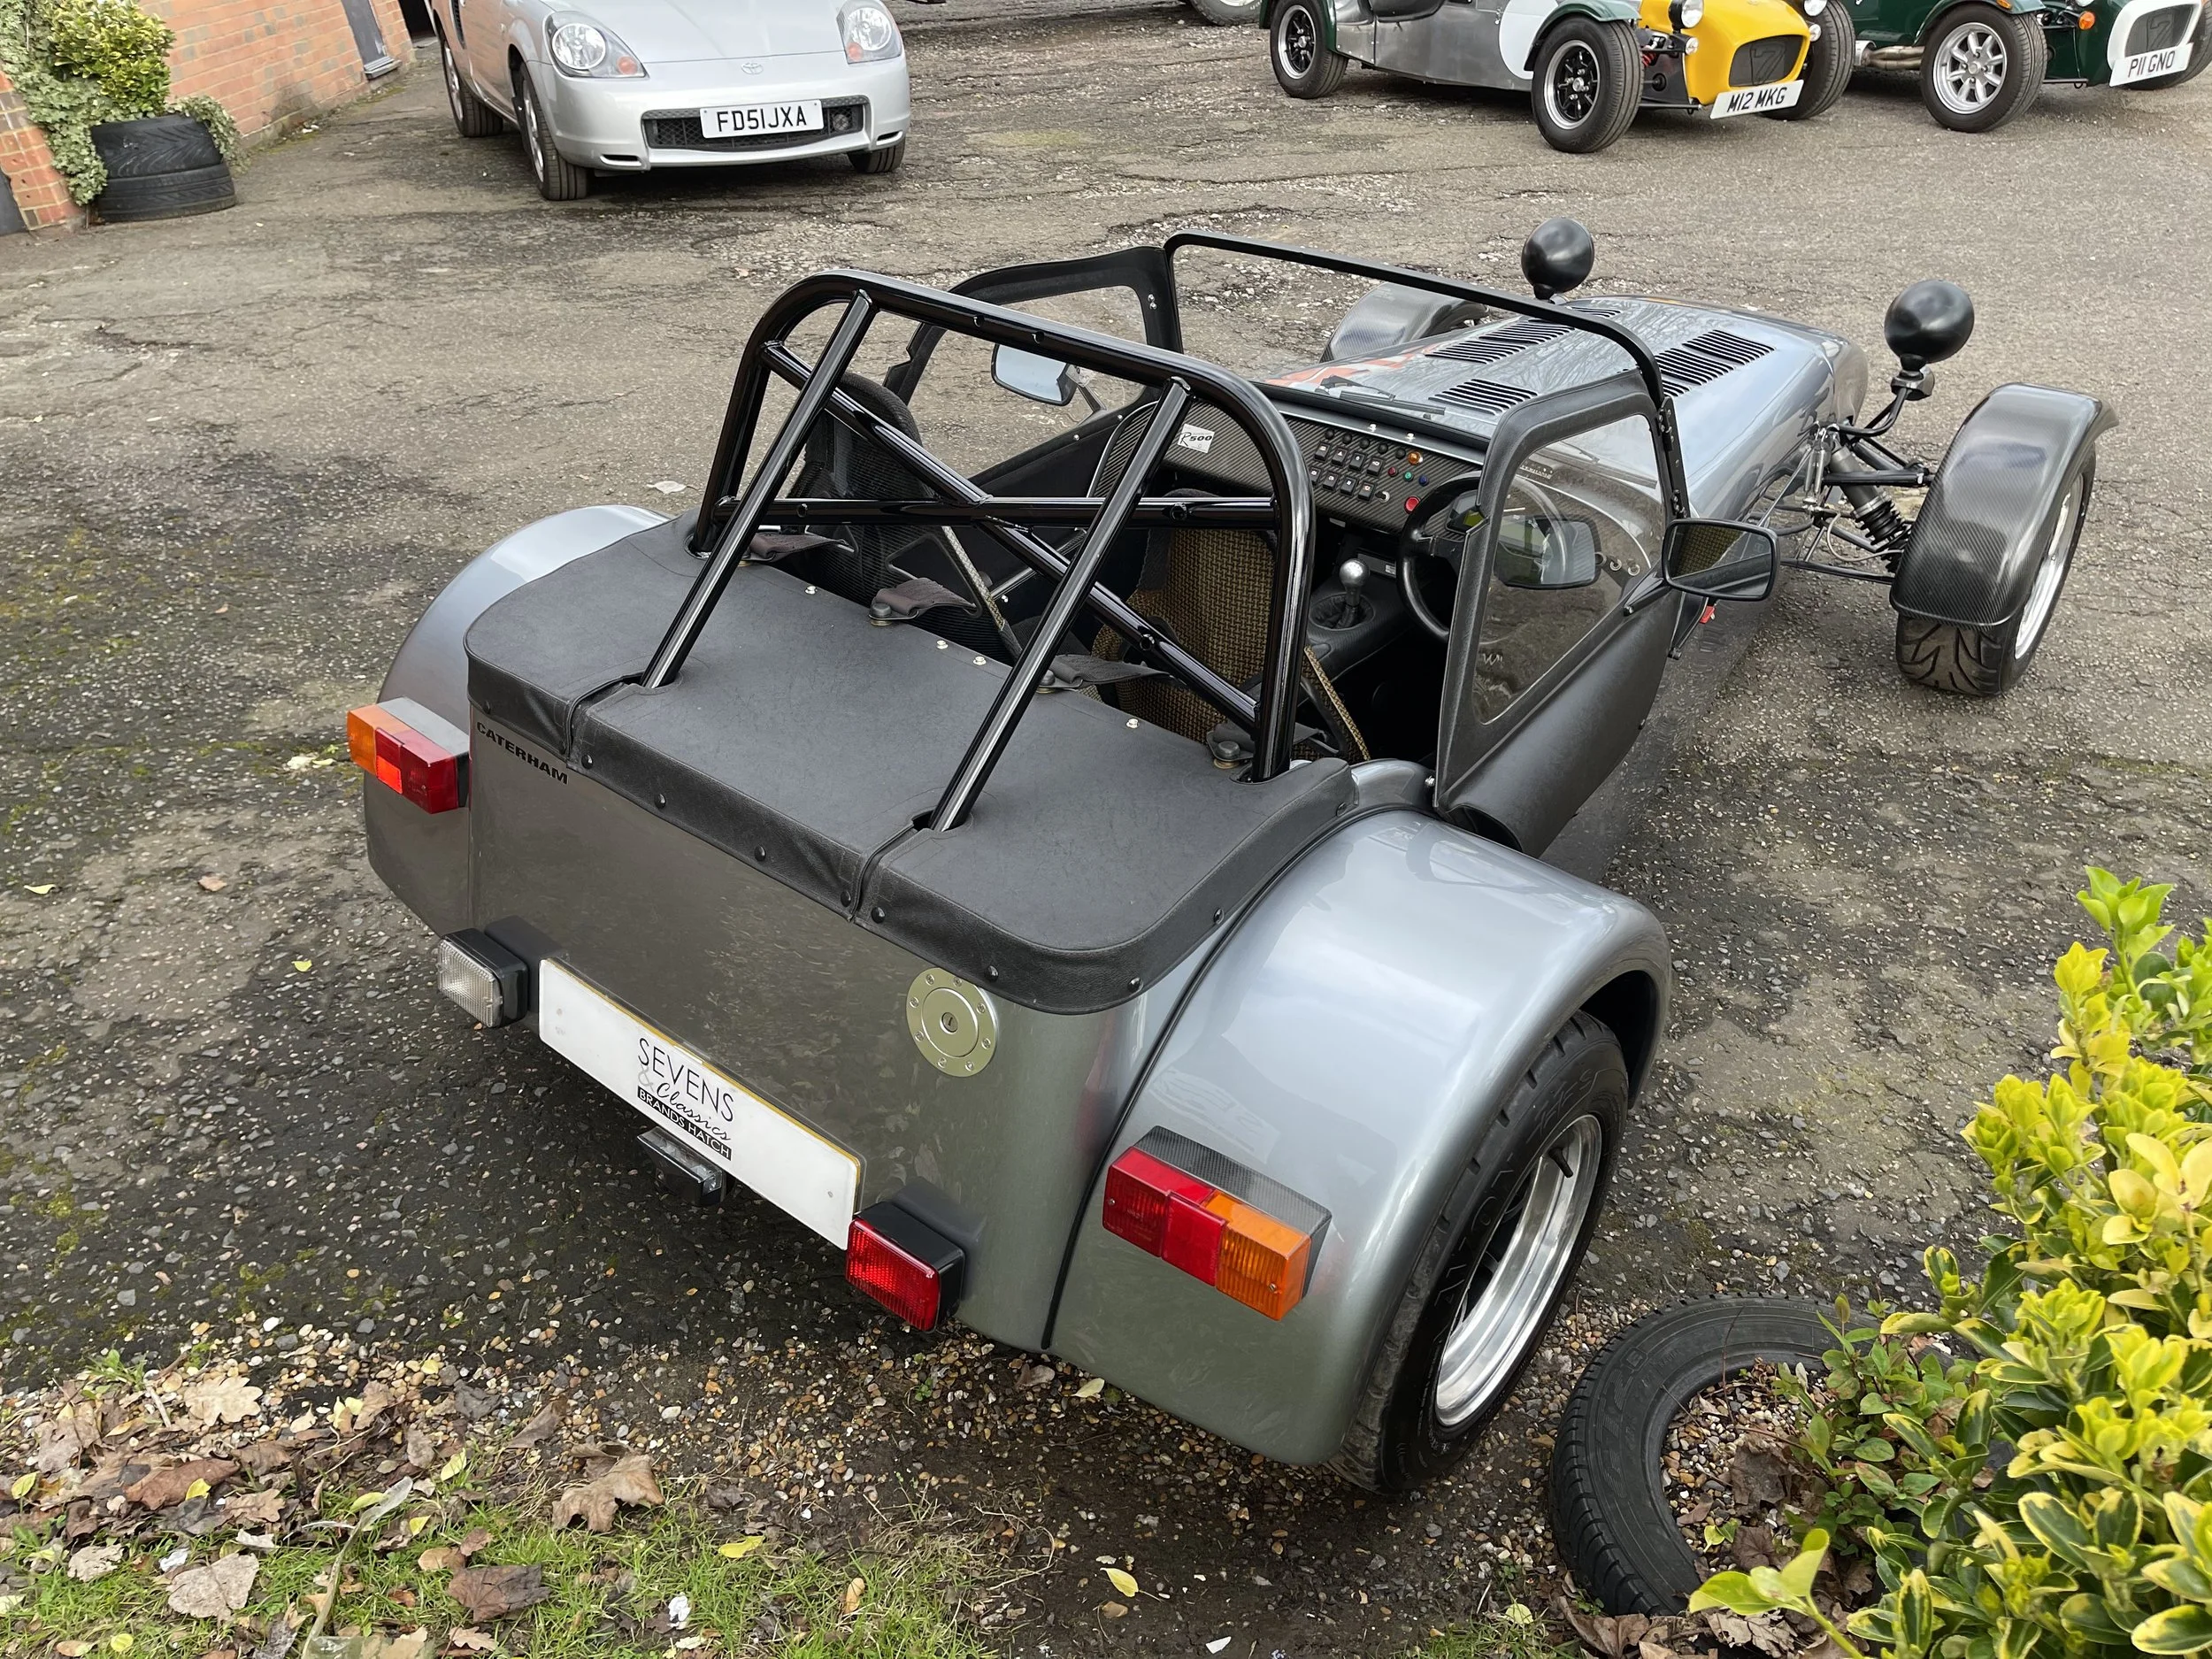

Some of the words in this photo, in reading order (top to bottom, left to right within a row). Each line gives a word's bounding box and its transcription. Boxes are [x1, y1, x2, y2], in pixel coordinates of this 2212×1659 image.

[2147, 50, 2176, 73] GNO
[1727, 92, 1755, 113] M12
[1755, 87, 1787, 108] MKG
[477, 721, 568, 785] CATERHAM
[638, 1038, 733, 1122] SEVENS
[639, 1089, 686, 1128] BRANDS
[687, 1122, 731, 1159] HATCH
[657, 1082, 731, 1141] Classics
